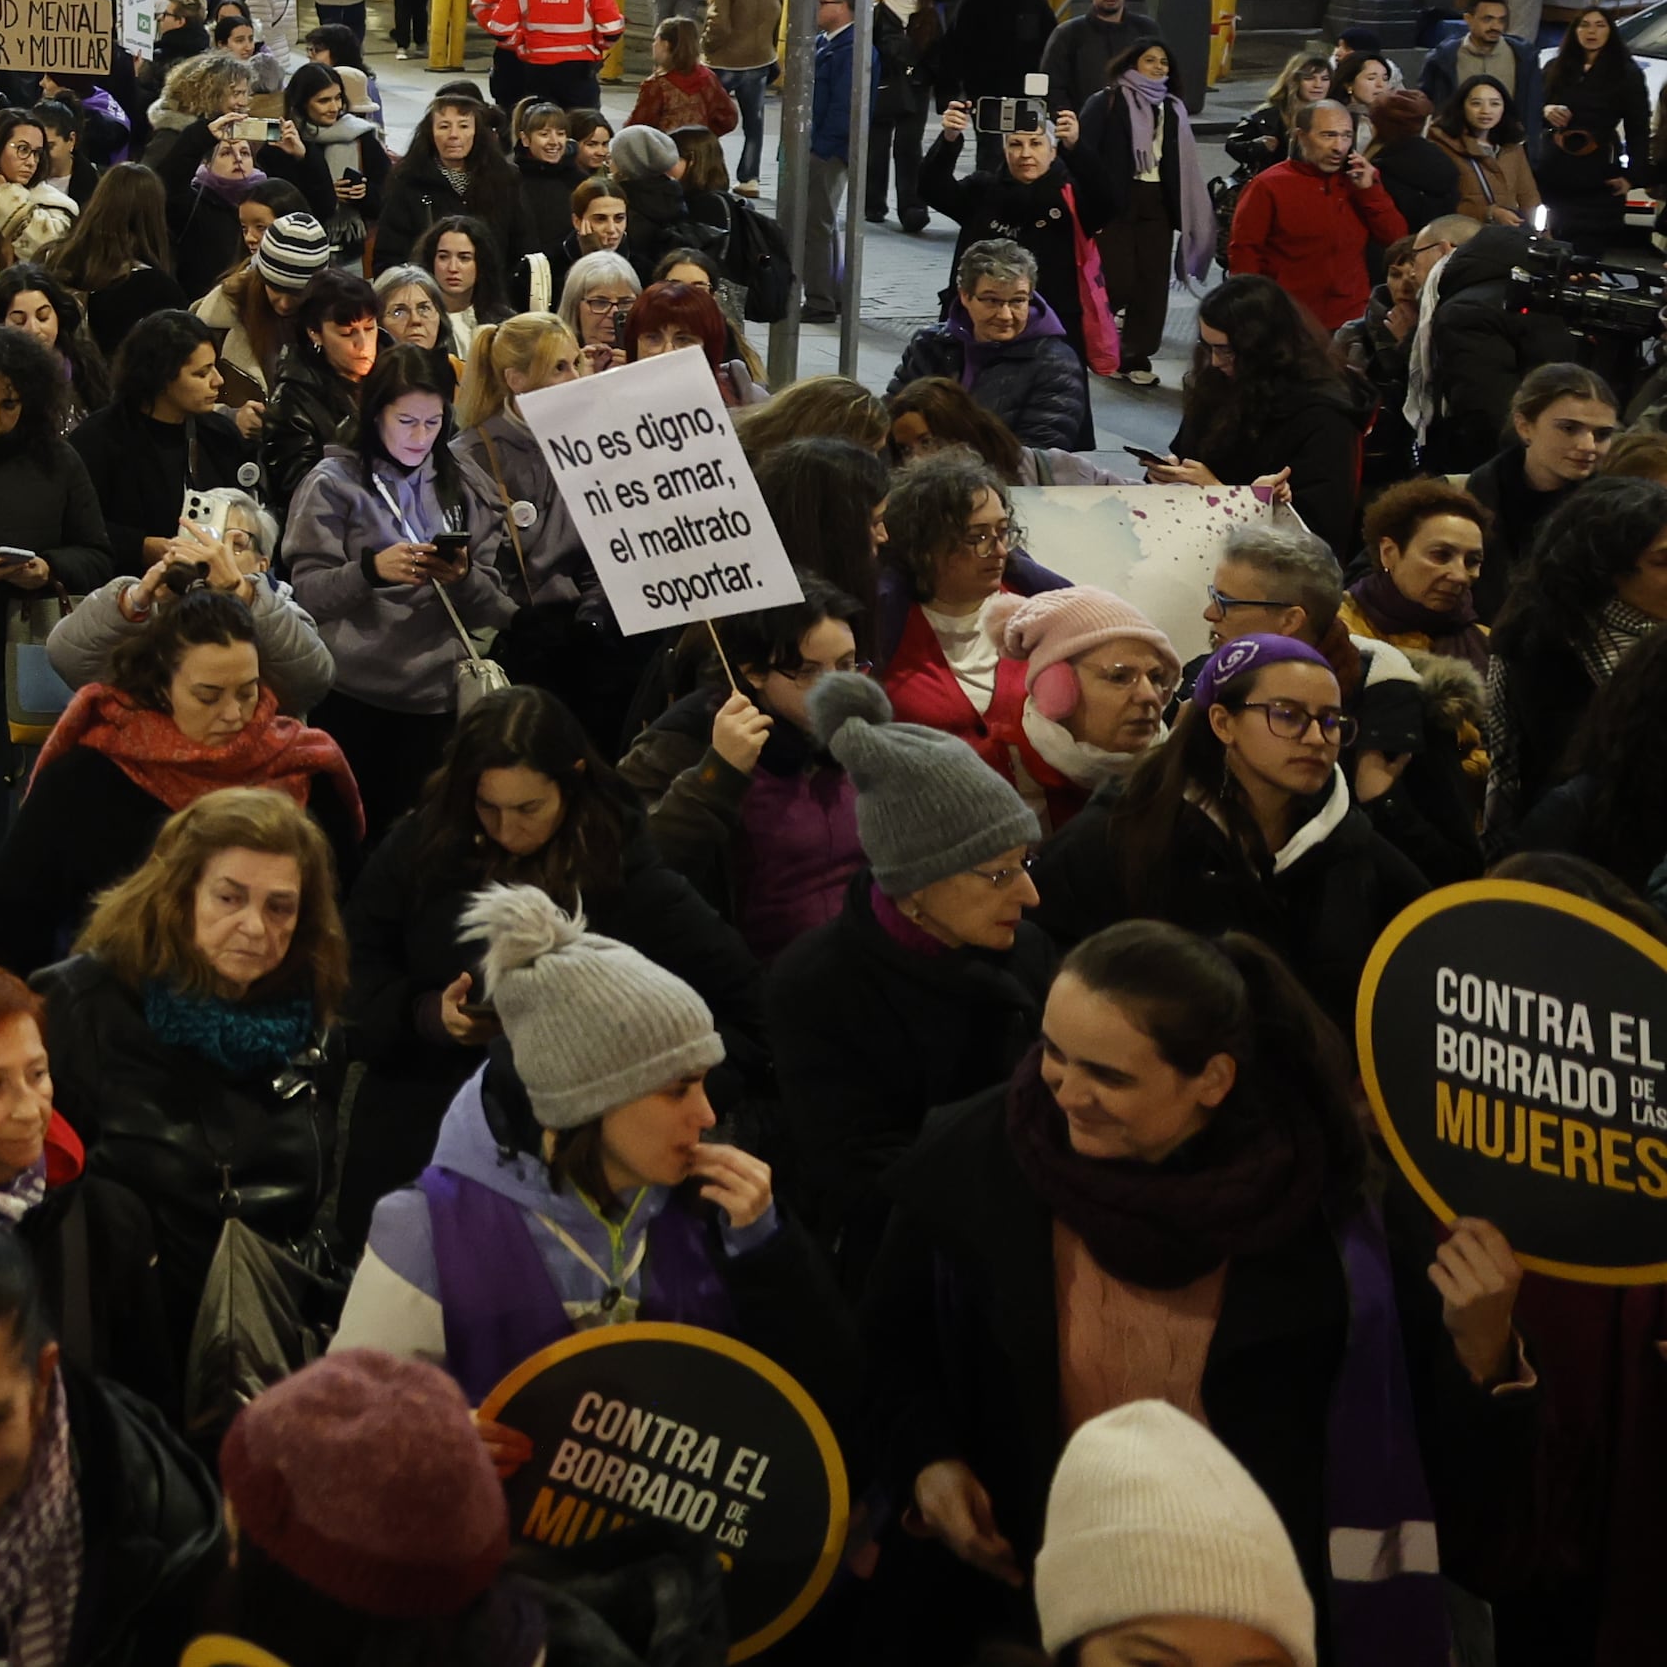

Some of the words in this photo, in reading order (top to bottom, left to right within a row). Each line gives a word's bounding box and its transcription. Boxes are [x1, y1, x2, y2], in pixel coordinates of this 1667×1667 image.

[27, 0, 109, 36] MENTAL
[29, 35, 109, 72] MUTILAR
[548, 435, 593, 471] No
[597, 430, 632, 461] es
[636, 406, 726, 452] digno,
[583, 480, 613, 516] ni
[616, 478, 650, 509] es
[653, 457, 737, 501] amar,
[610, 527, 637, 564] el
[638, 506, 752, 558] maltrato
[642, 561, 763, 612] soportar.
[1436, 966, 1596, 1057] CONTRA
[1609, 1010, 1666, 1072] EL
[1436, 1022, 1617, 1119] BORRADO
[1629, 1074, 1655, 1103] DE
[1436, 1080, 1667, 1200] MUJERES
[1631, 1100, 1667, 1131] LAS
[571, 1390, 721, 1481] CONTRA
[723, 1446, 771, 1501] EL
[548, 1438, 719, 1533] BORRADO
[727, 1499, 750, 1524] DE
[715, 1522, 749, 1549] LAS
